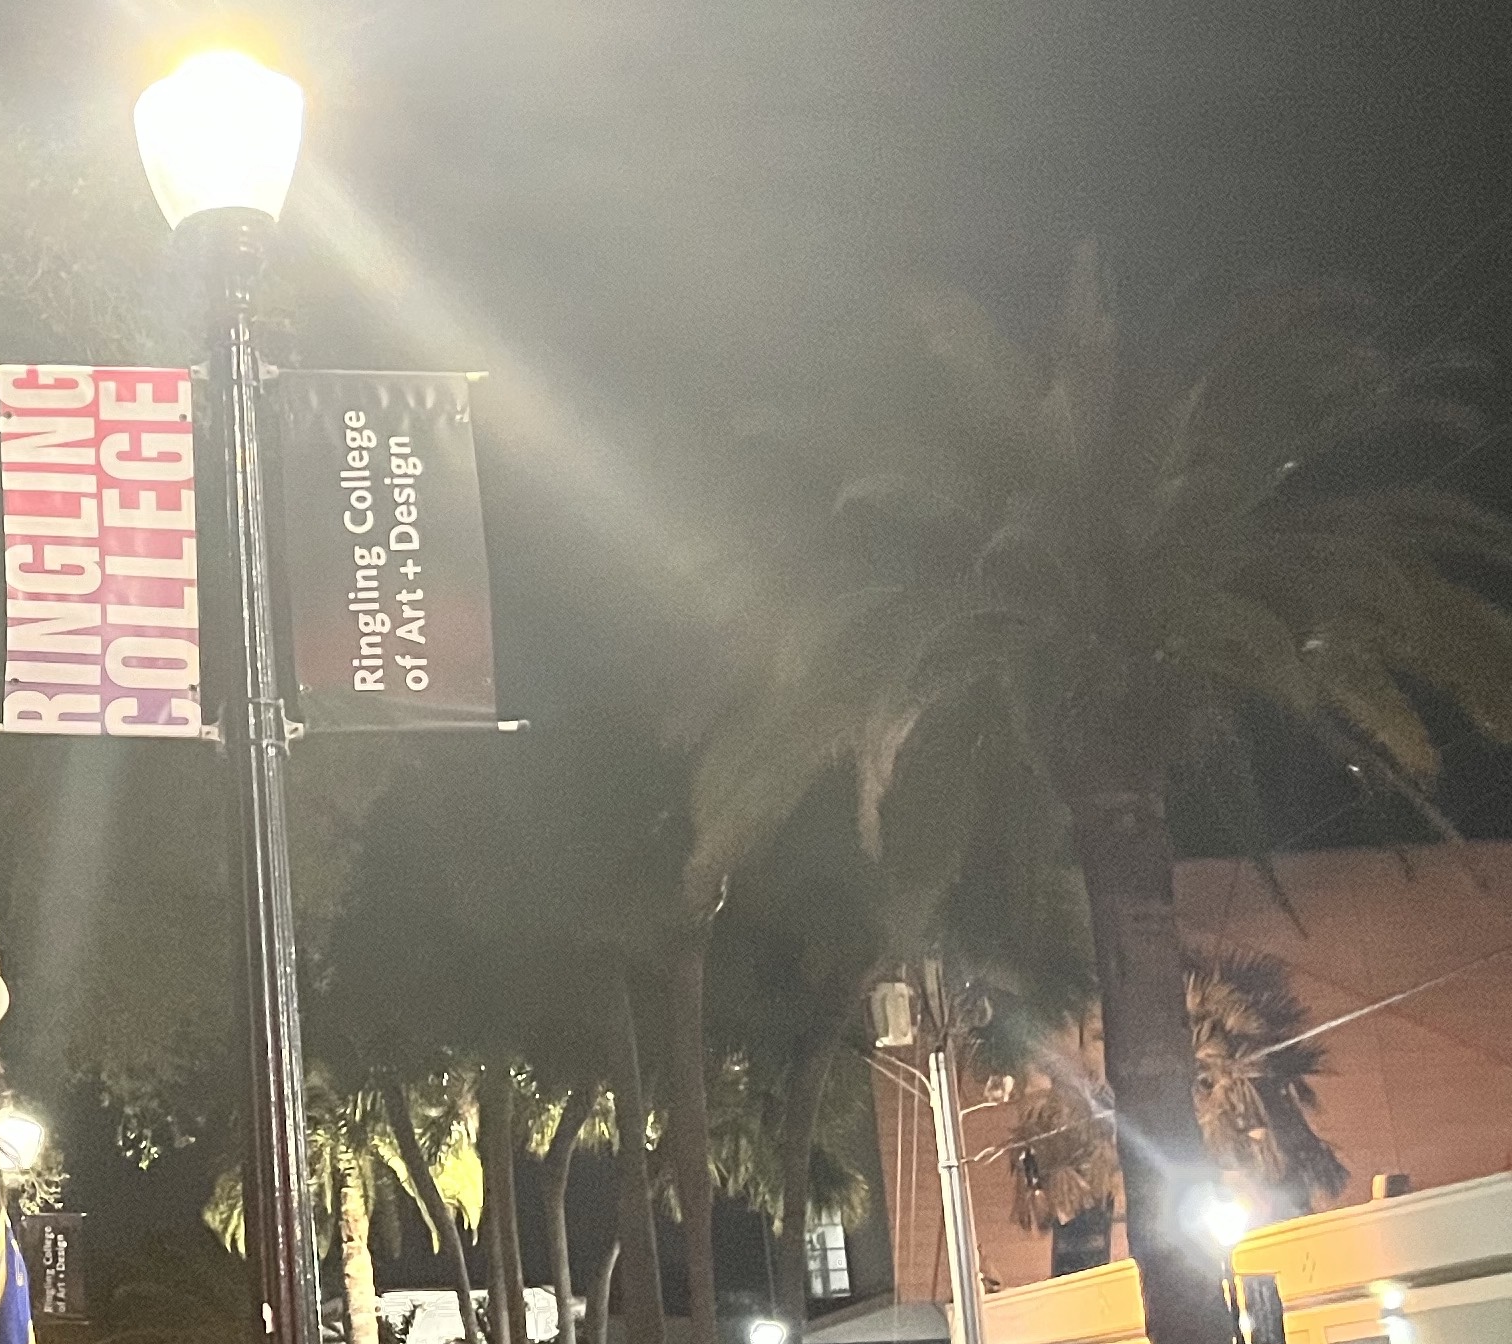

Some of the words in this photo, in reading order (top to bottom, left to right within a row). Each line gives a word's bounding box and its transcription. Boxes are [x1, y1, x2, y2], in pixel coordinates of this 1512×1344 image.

[340, 410, 378, 534] College
[384, 436, 423, 551] Design
[0, 365, 102, 734] RINGLING
[99, 381, 202, 737] COLLEGE
[399, 558, 422, 581] +
[348, 545, 391, 691] Ringling
[394, 654, 429, 691] of
[395, 588, 426, 644] Art
